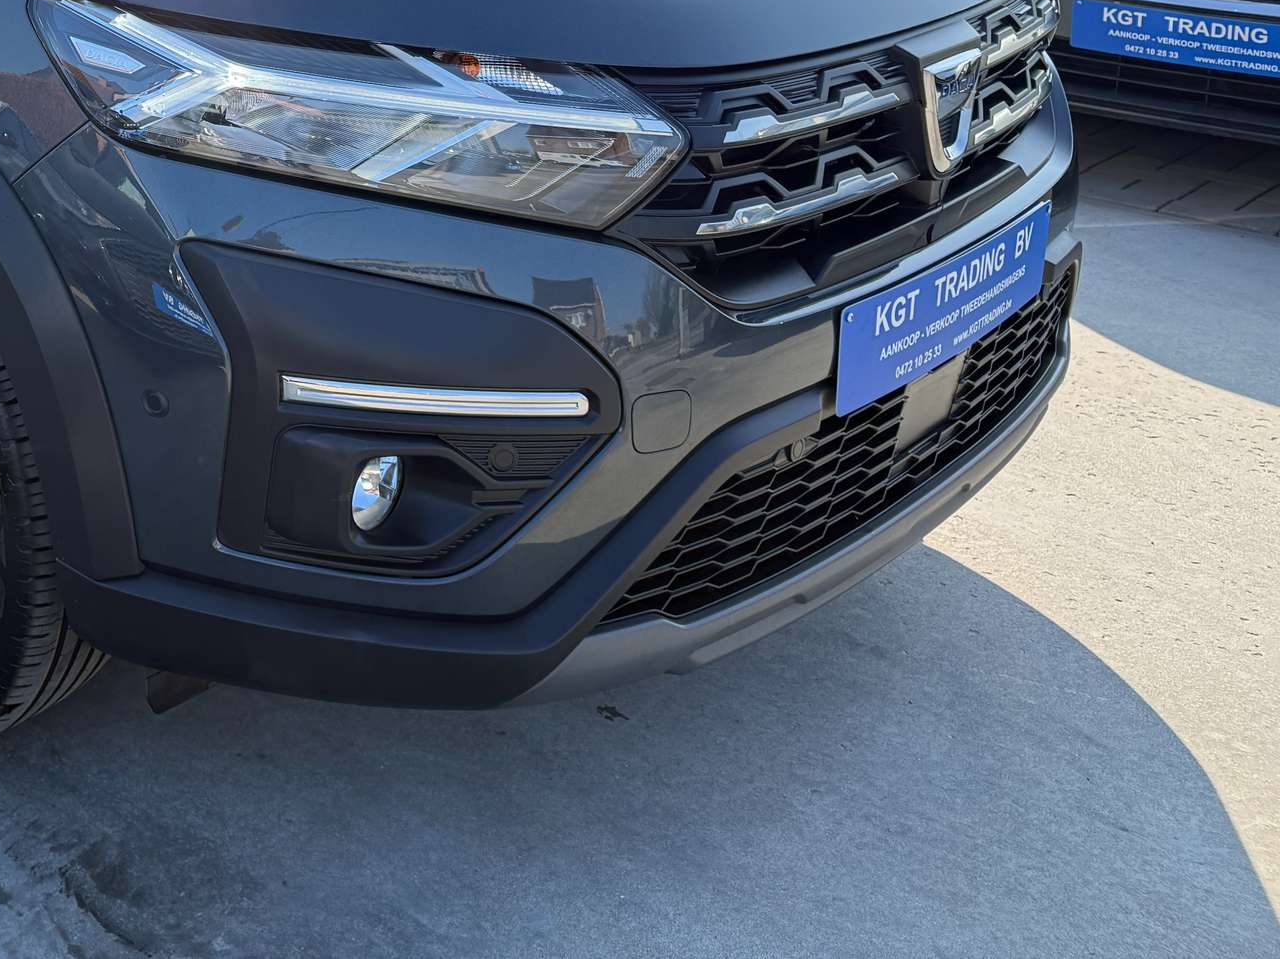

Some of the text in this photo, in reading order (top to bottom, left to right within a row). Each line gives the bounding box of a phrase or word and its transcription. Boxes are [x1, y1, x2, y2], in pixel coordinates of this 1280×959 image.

[1102, 6, 1269, 44] KGT TRADING
[1108, 29, 1151, 41] AANKOOP
[1156, 36, 1200, 49] VERKOOP
[1124, 44, 1144, 54] 0472
[874, 221, 1034, 337] KGT TRADING BV
[880, 332, 920, 361] AANKOOP
[925, 310, 960, 337] VERKOOP
[960, 264, 1026, 318] TWEEDEHANDSWAGENS
[895, 363, 913, 379] 0472
[933, 343, 942, 358] 33
